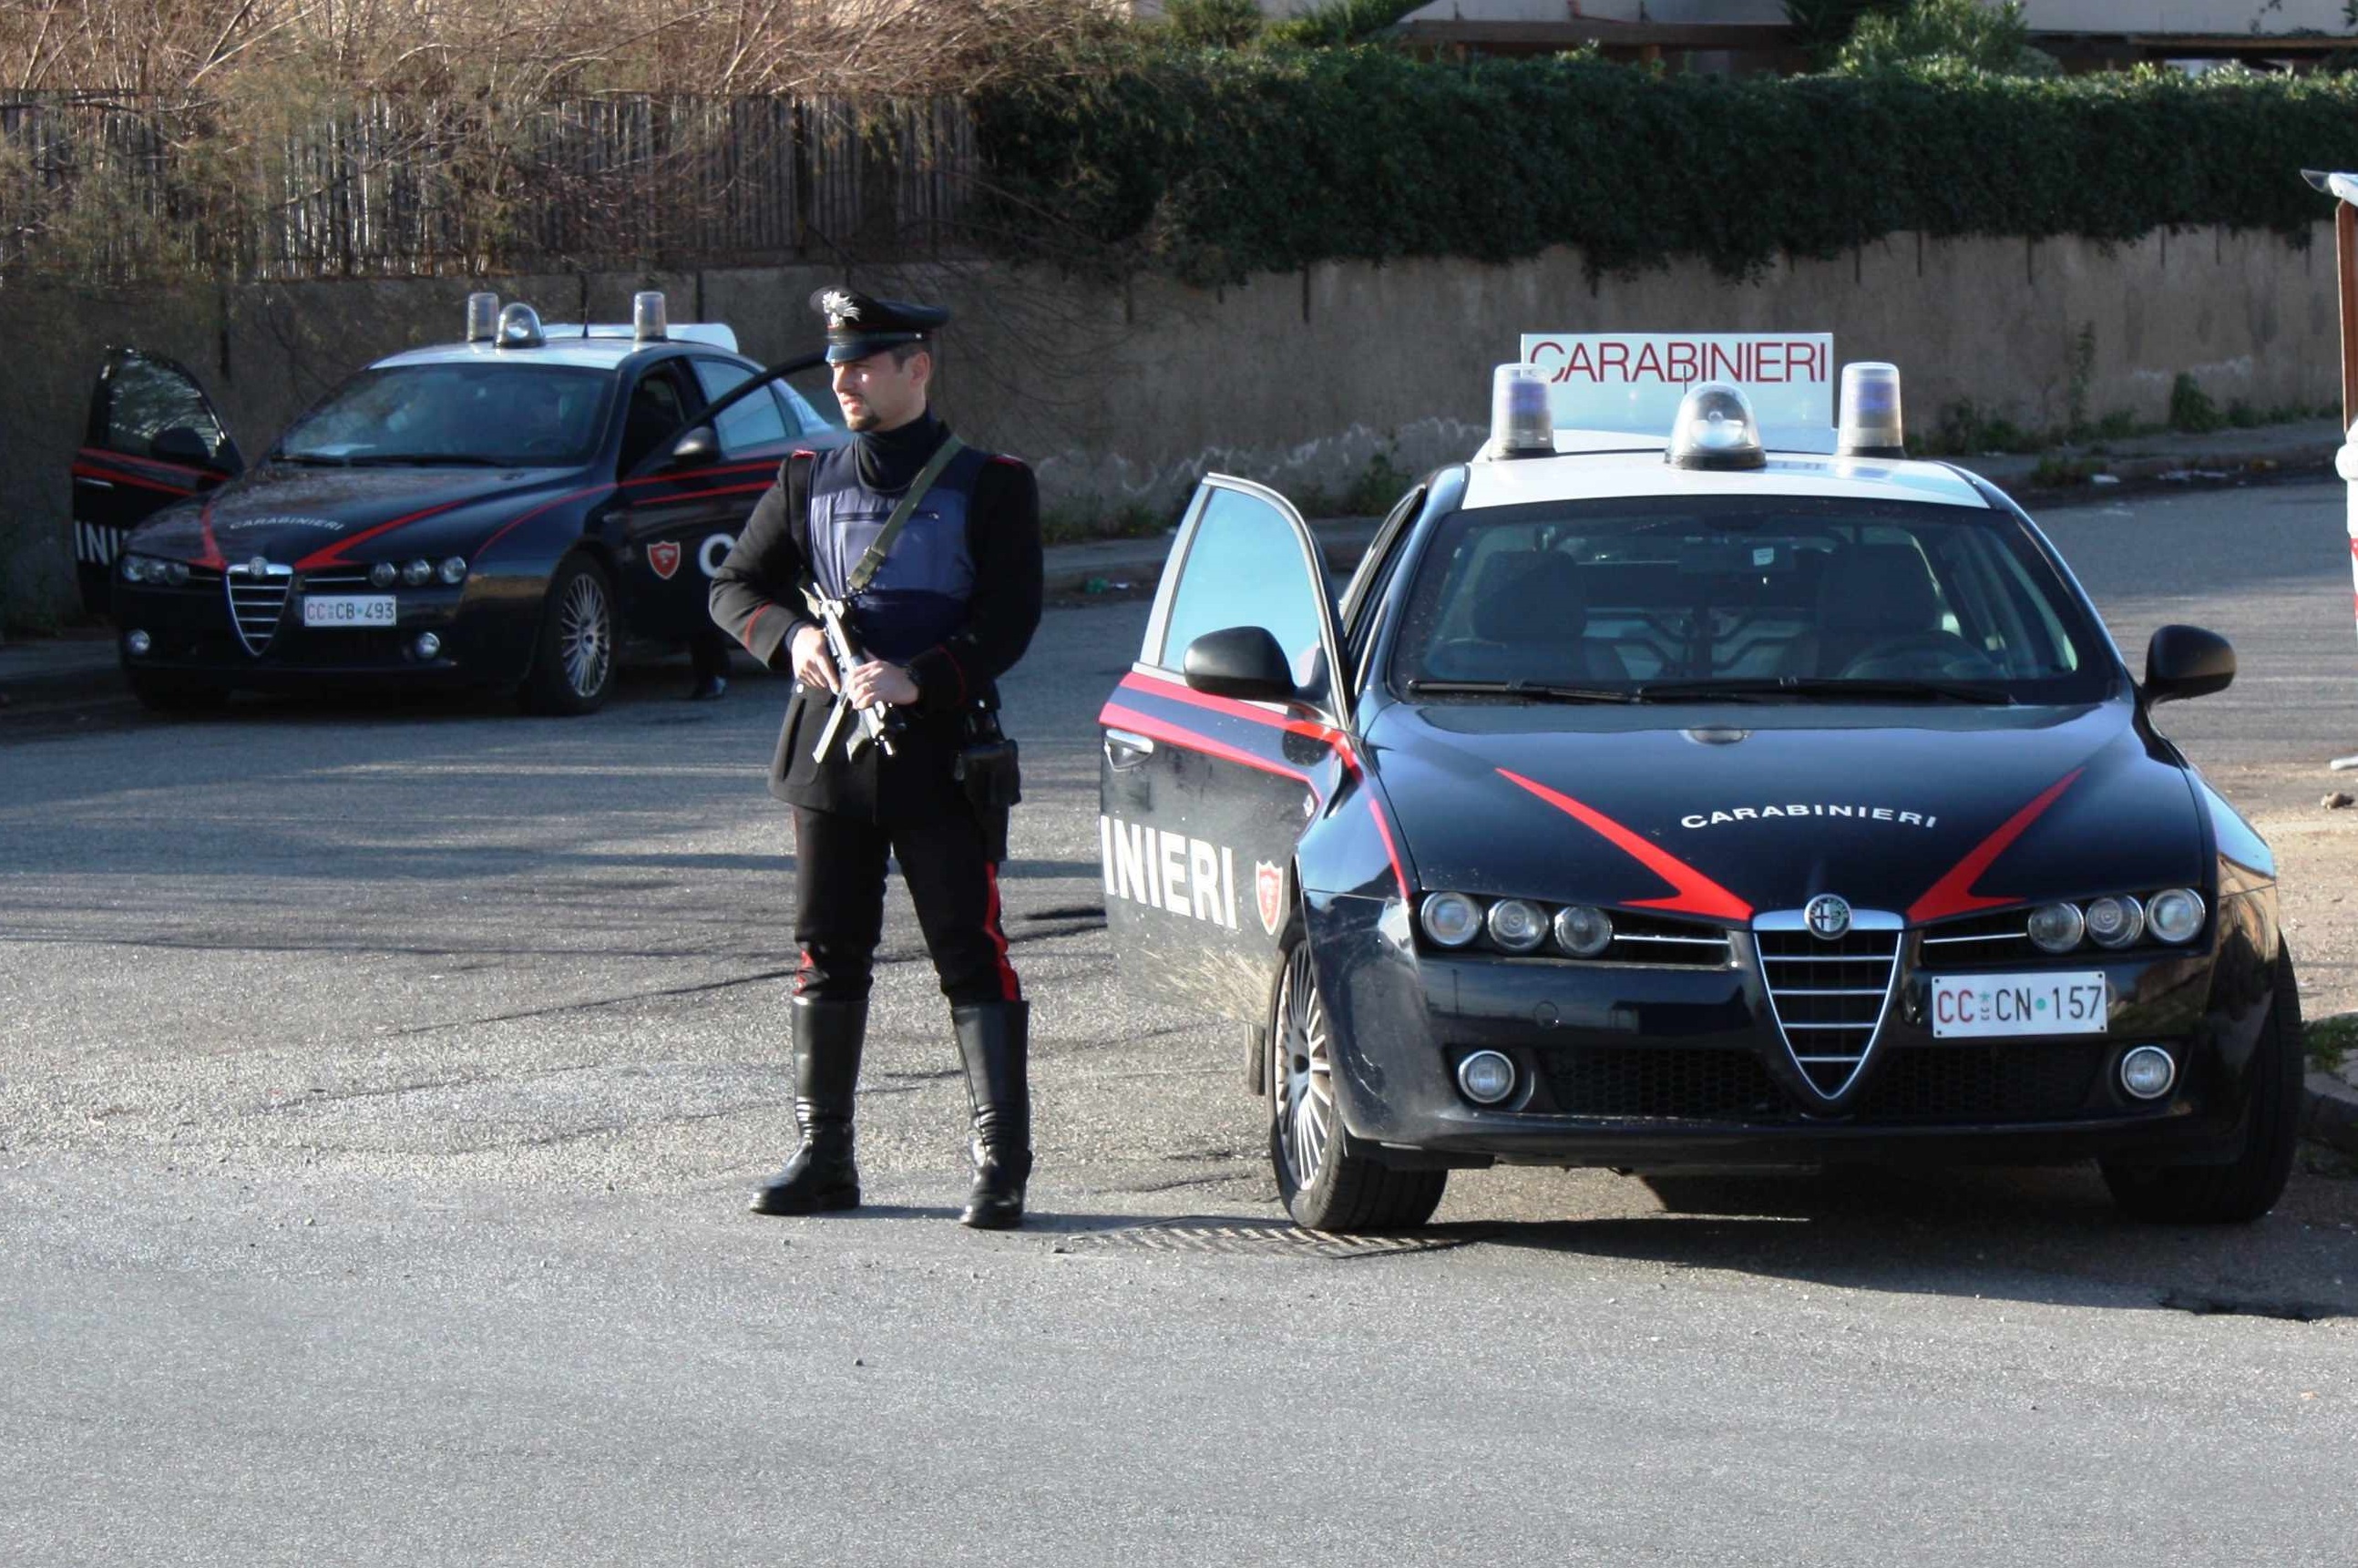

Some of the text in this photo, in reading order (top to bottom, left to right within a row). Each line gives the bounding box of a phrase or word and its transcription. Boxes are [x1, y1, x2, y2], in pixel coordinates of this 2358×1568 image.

[1530, 342, 1826, 383] CARABINIERI
[1681, 804, 1937, 828] CARABINIERI
[1101, 815, 1237, 929] INIERI
[1937, 989, 1974, 1023] CC
[1996, 988, 2031, 1021] CN
[2052, 986, 2101, 1020] 157
